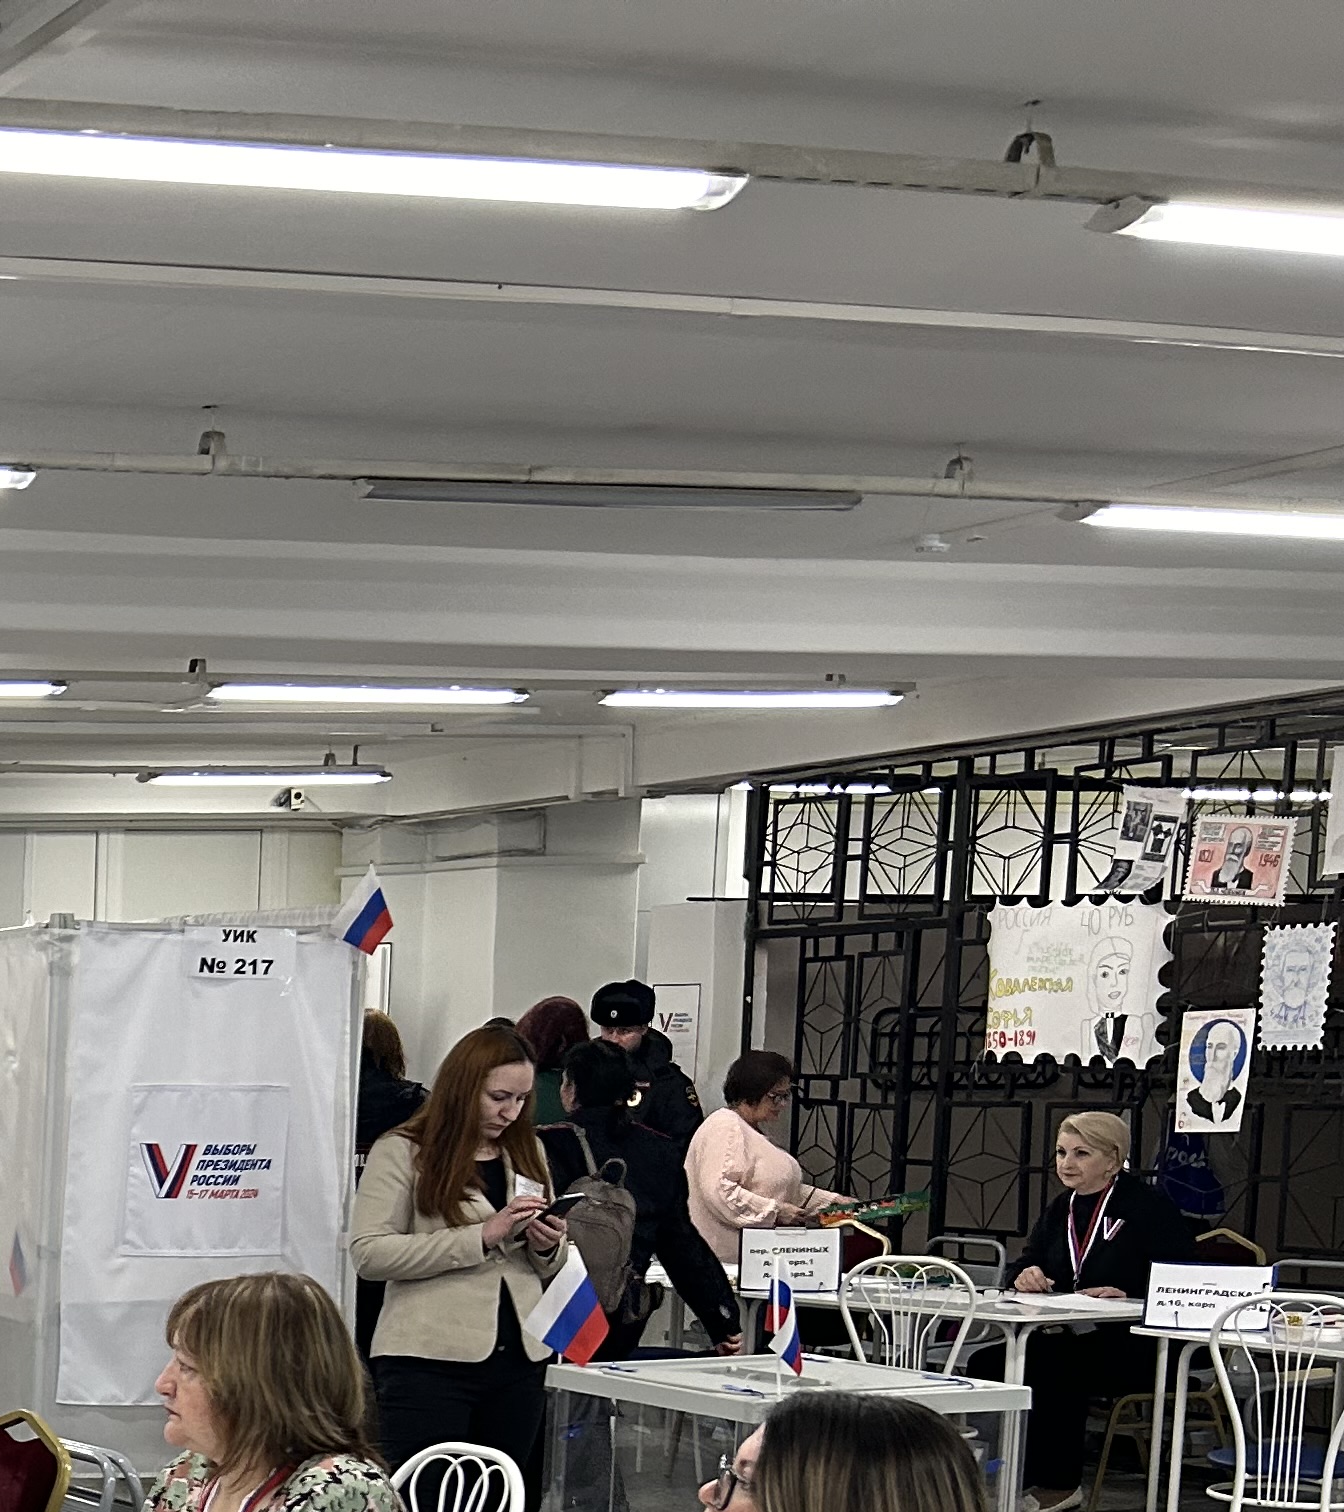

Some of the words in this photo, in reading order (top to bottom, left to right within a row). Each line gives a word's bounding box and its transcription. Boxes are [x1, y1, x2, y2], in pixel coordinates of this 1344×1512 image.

[997, 907, 1053, 930] РОССИЯ
[1080, 908, 1102, 936] 40
[1108, 905, 1134, 929] РУБ
[221, 928, 258, 943] УИК
[198, 957, 226, 973] №
[233, 958, 274, 975] 217
[202, 1143, 257, 1156] ВЫБОРЫ
[195, 1158, 272, 1173] ПРЕЗИДЕНТА
[190, 1174, 242, 1187] РОССИИ
[1155, 1286, 1258, 1298] ЛЕНИНГРАДСКА
